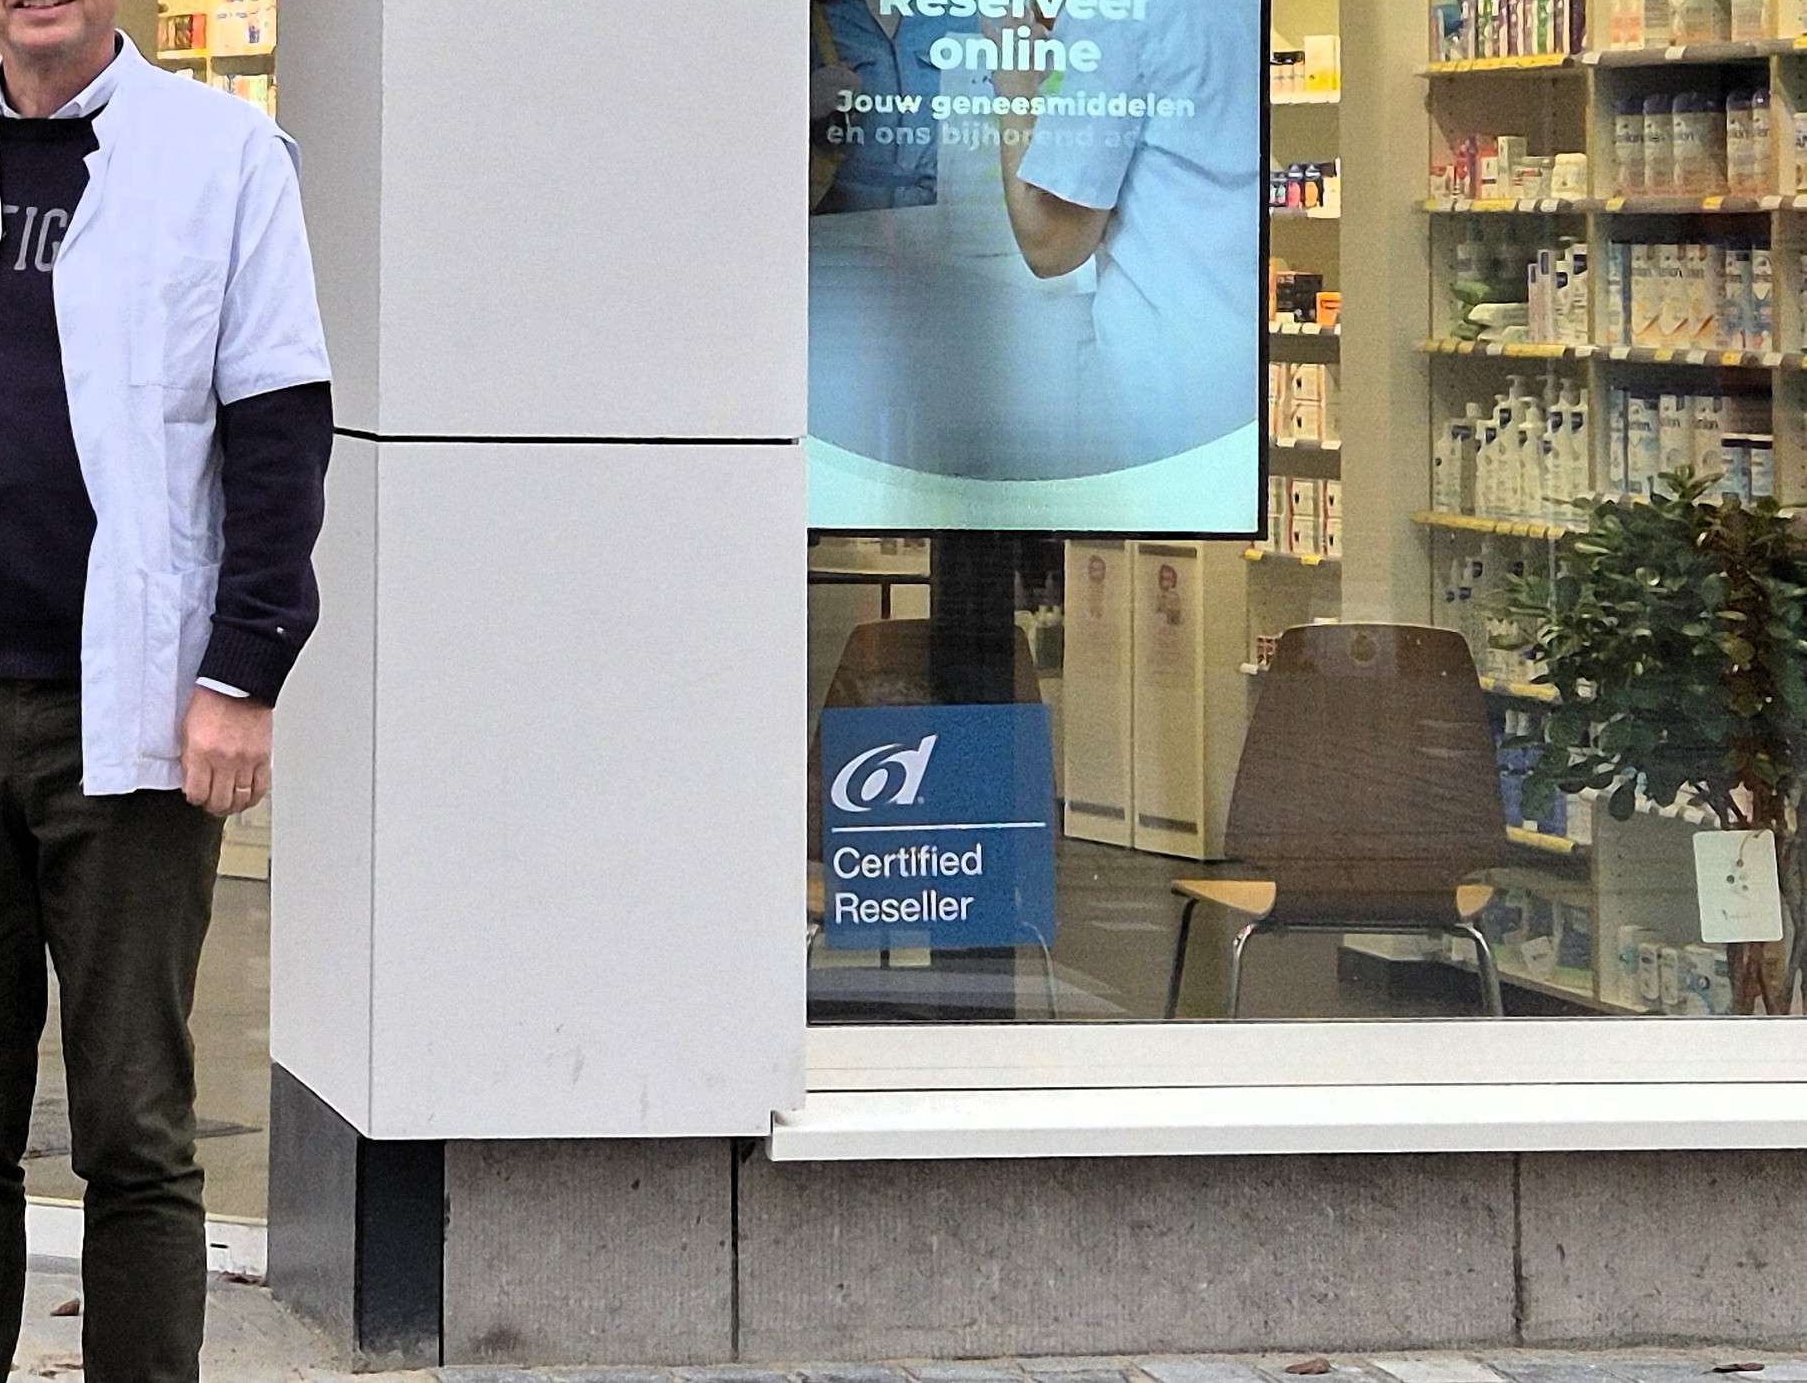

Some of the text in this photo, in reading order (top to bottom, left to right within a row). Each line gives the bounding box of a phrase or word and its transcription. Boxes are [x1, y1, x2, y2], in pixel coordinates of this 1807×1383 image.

[930, 25, 1101, 72] online
[836, 89, 1195, 119] Jouw geneesmiddelen
[827, 125, 865, 146] en
[875, 123, 930, 146] ons
[833, 842, 983, 879] Certified
[835, 889, 975, 924] Reseller
